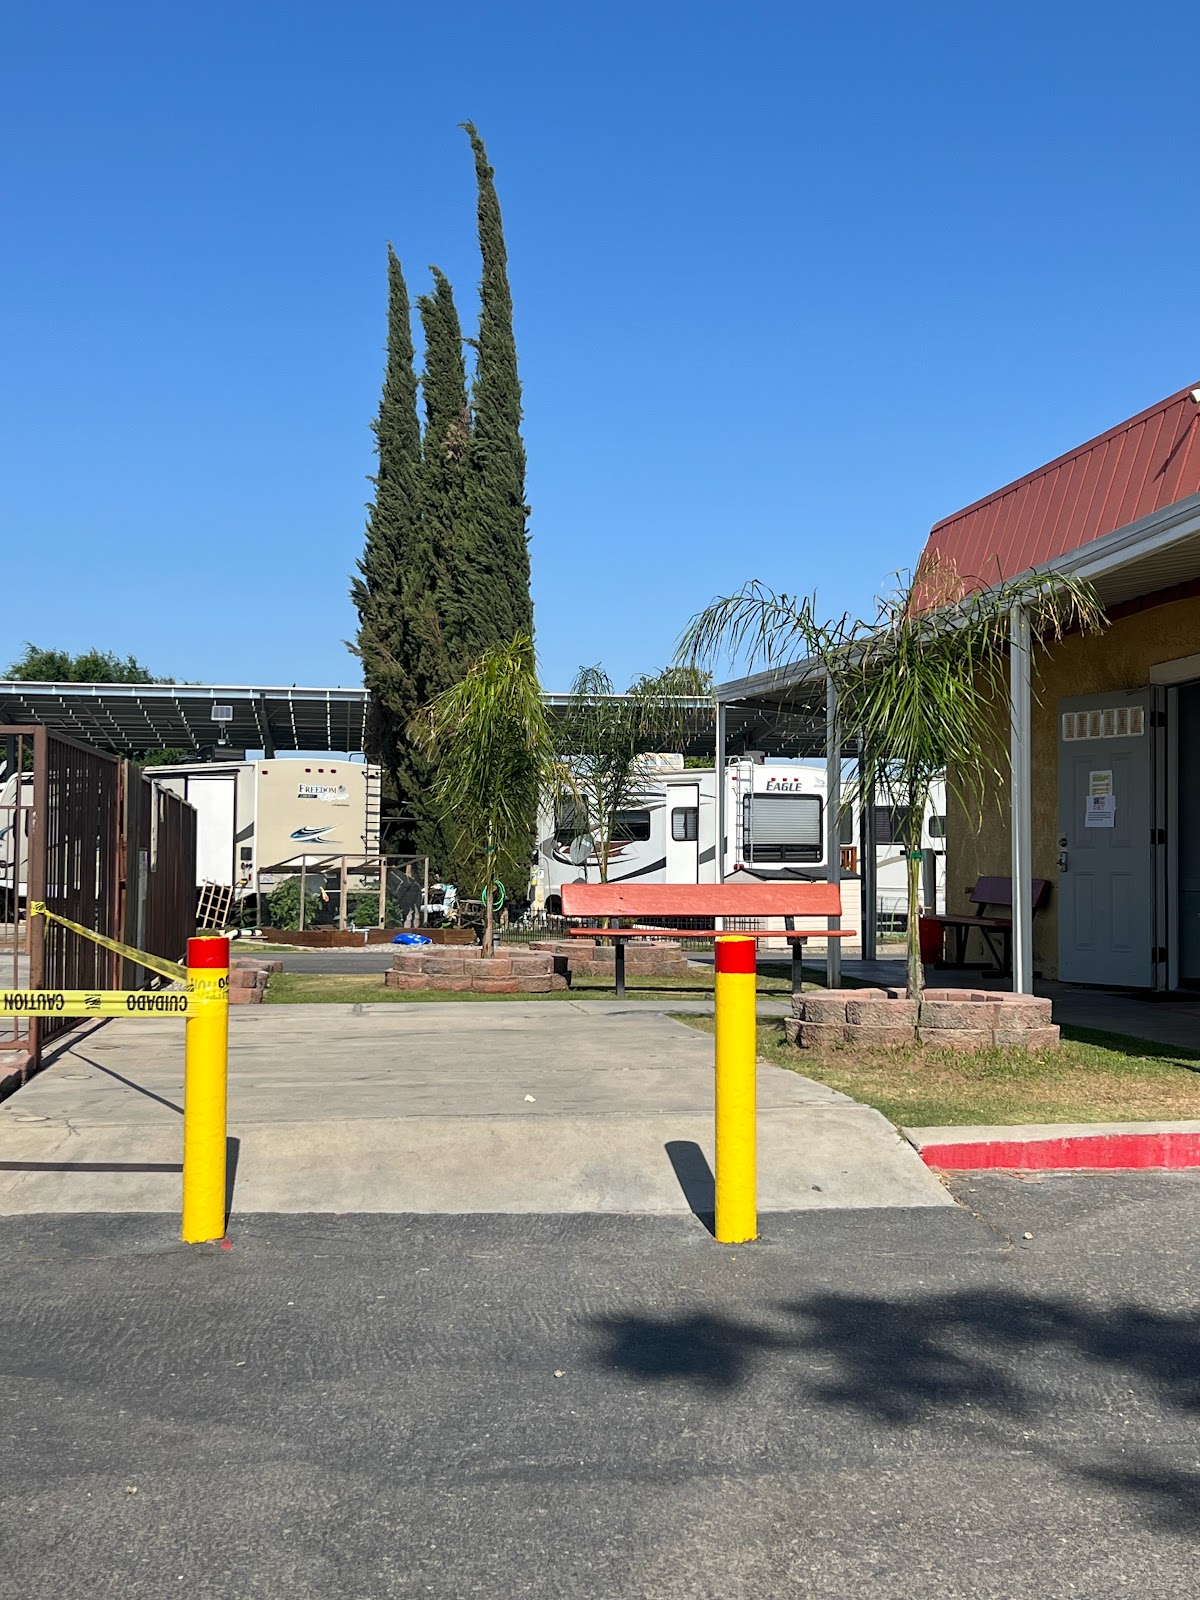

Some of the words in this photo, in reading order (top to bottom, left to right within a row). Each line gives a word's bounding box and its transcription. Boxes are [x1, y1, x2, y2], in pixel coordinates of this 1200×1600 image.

[299, 784, 337, 794] FREEDOM
[766, 781, 802, 792] EAGLE
[4, 993, 65, 1011] CAUTION
[126, 994, 188, 1011] CUIDADO
